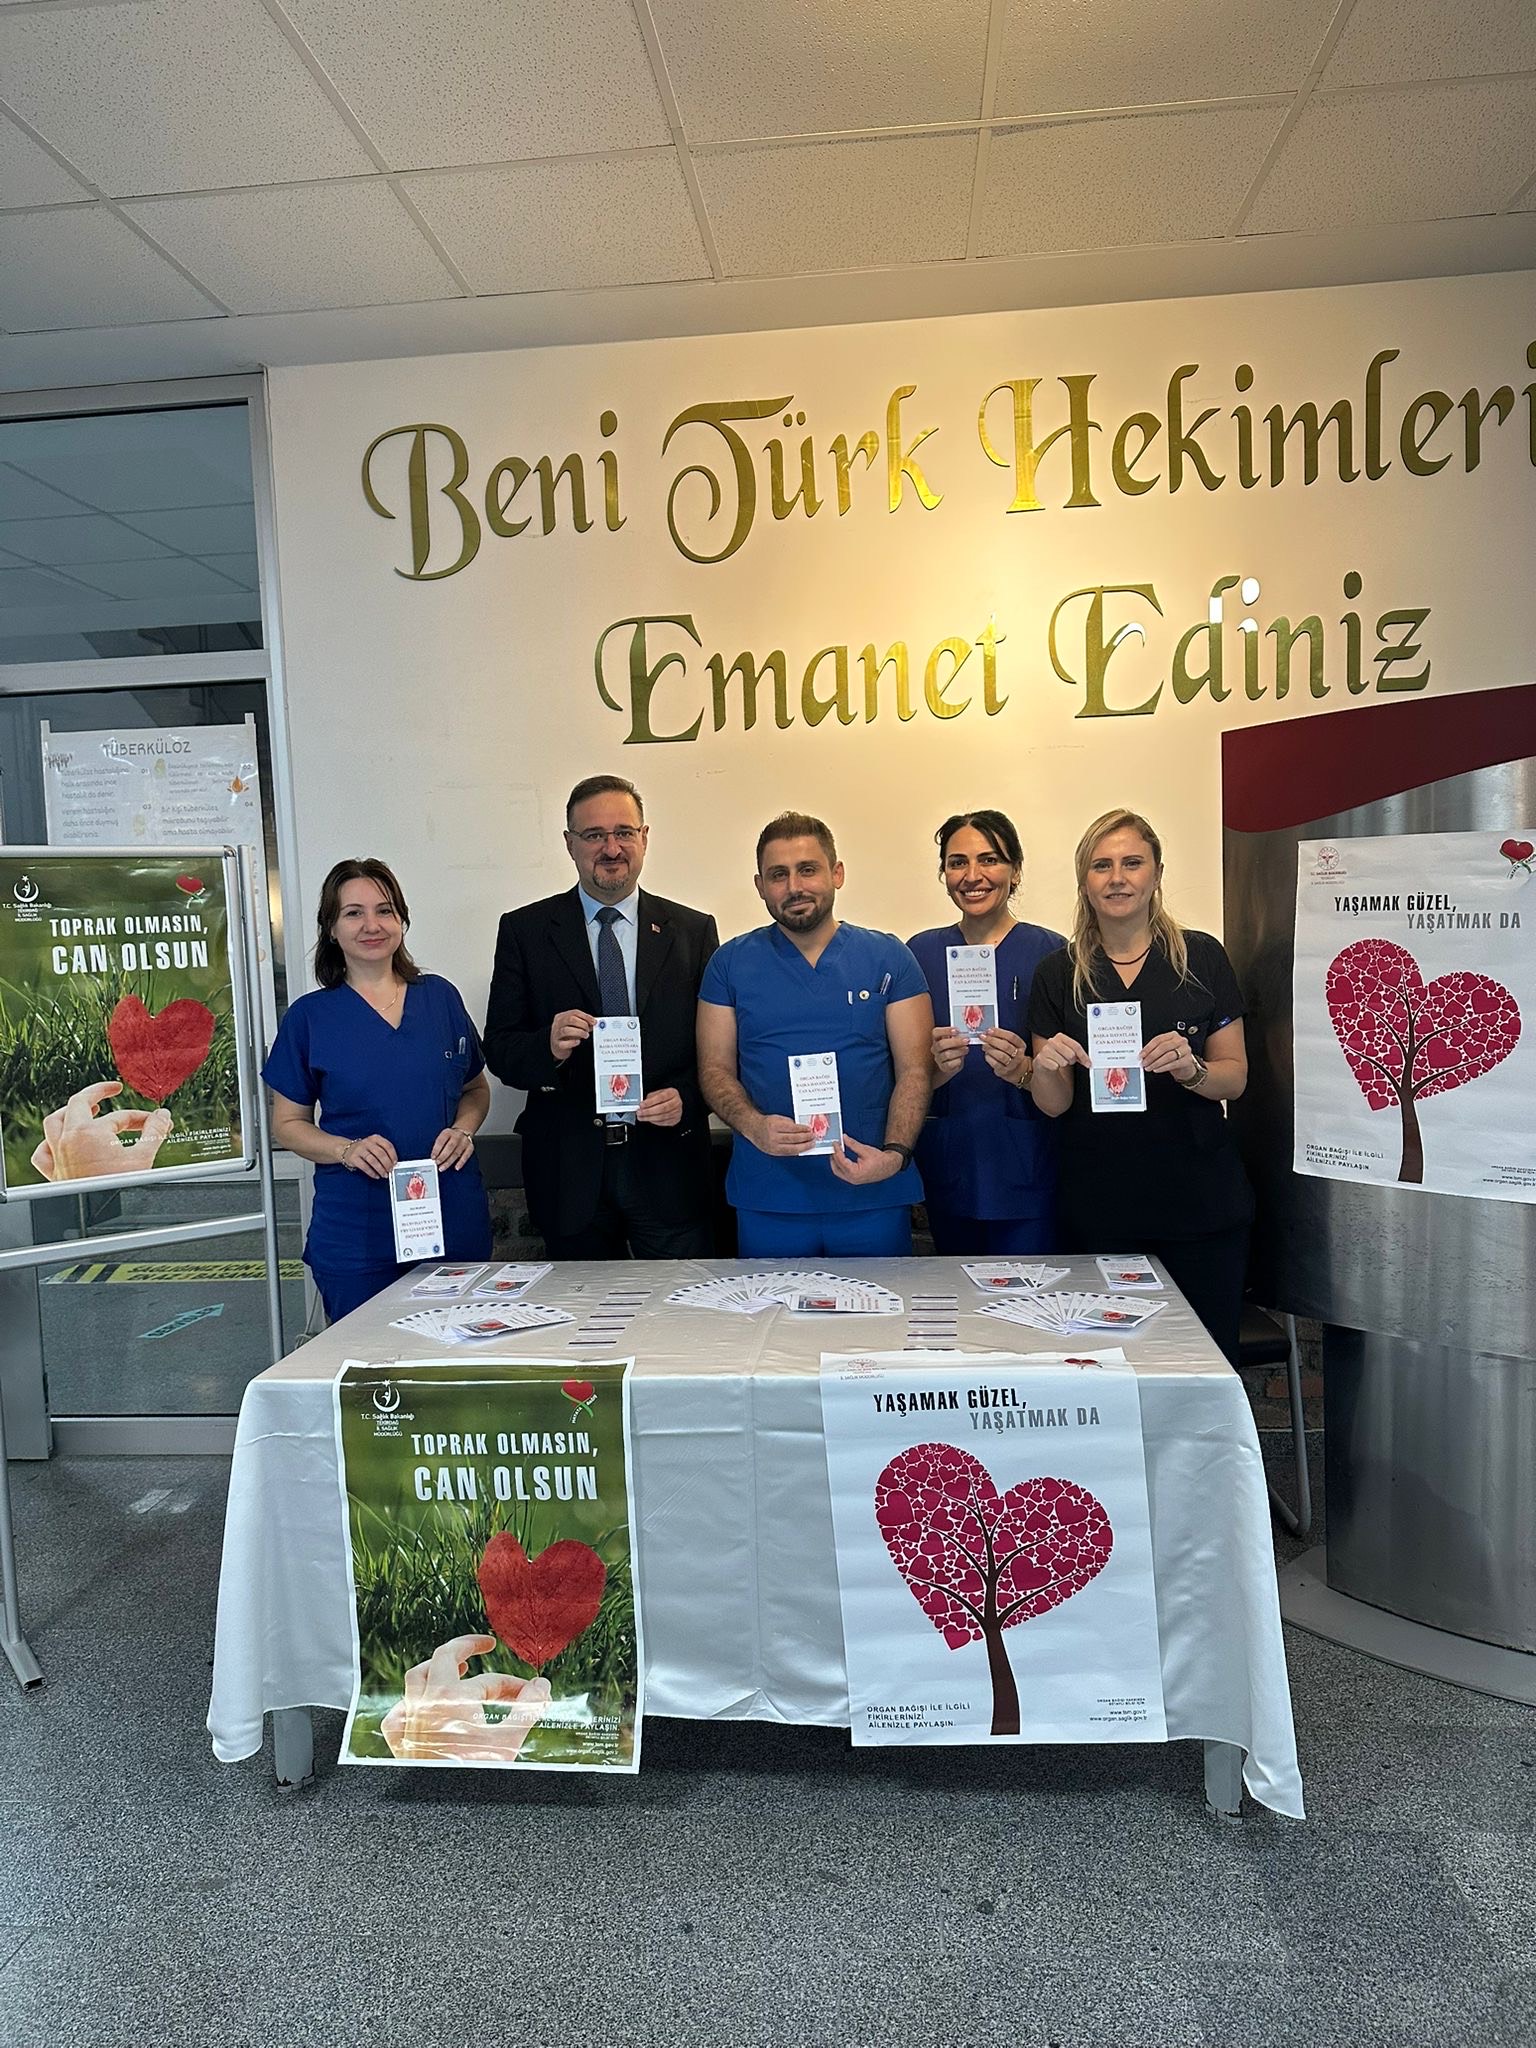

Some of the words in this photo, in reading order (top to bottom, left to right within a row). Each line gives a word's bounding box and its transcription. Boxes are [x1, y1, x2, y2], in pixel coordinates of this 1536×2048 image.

[361, 410, 627, 581] Beni
[663, 384, 945, 564] Türk
[594, 612, 1010, 744] Emanet
[1048, 570, 1432, 718] Ediniz
[1335, 895, 1400, 916] YAŞAMAK
[1407, 892, 1457, 912] GÜZEL,
[50, 917, 117, 937] TOPRAK
[124, 914, 208, 935] OLMASIN,
[1408, 913, 1491, 934] YAŞATMAK
[1500, 913, 1520, 929] DA
[52, 944, 108, 975] CAN
[121, 941, 208, 971] OLSUN
[873, 1391, 959, 1417] YAŞAMAK
[967, 1385, 1028, 1410] GÜZEL,
[969, 1408, 1068, 1434] YAŞATMAK
[1077, 1407, 1100, 1425] DA
[411, 1433, 488, 1456] TOPRAK
[497, 1432, 598, 1458] OLMASIN,
[414, 1466, 478, 1501] CAN
[493, 1466, 598, 1501] OLSUN
[866, 1705, 896, 1713] ORGAN
[899, 1704, 928, 1713] BAĞIŞI
[930, 1703, 943, 1711] İLE
[945, 1702, 970, 1710] İLGİLİ
[867, 1712, 925, 1721] FİKİRLERİNİZİ
